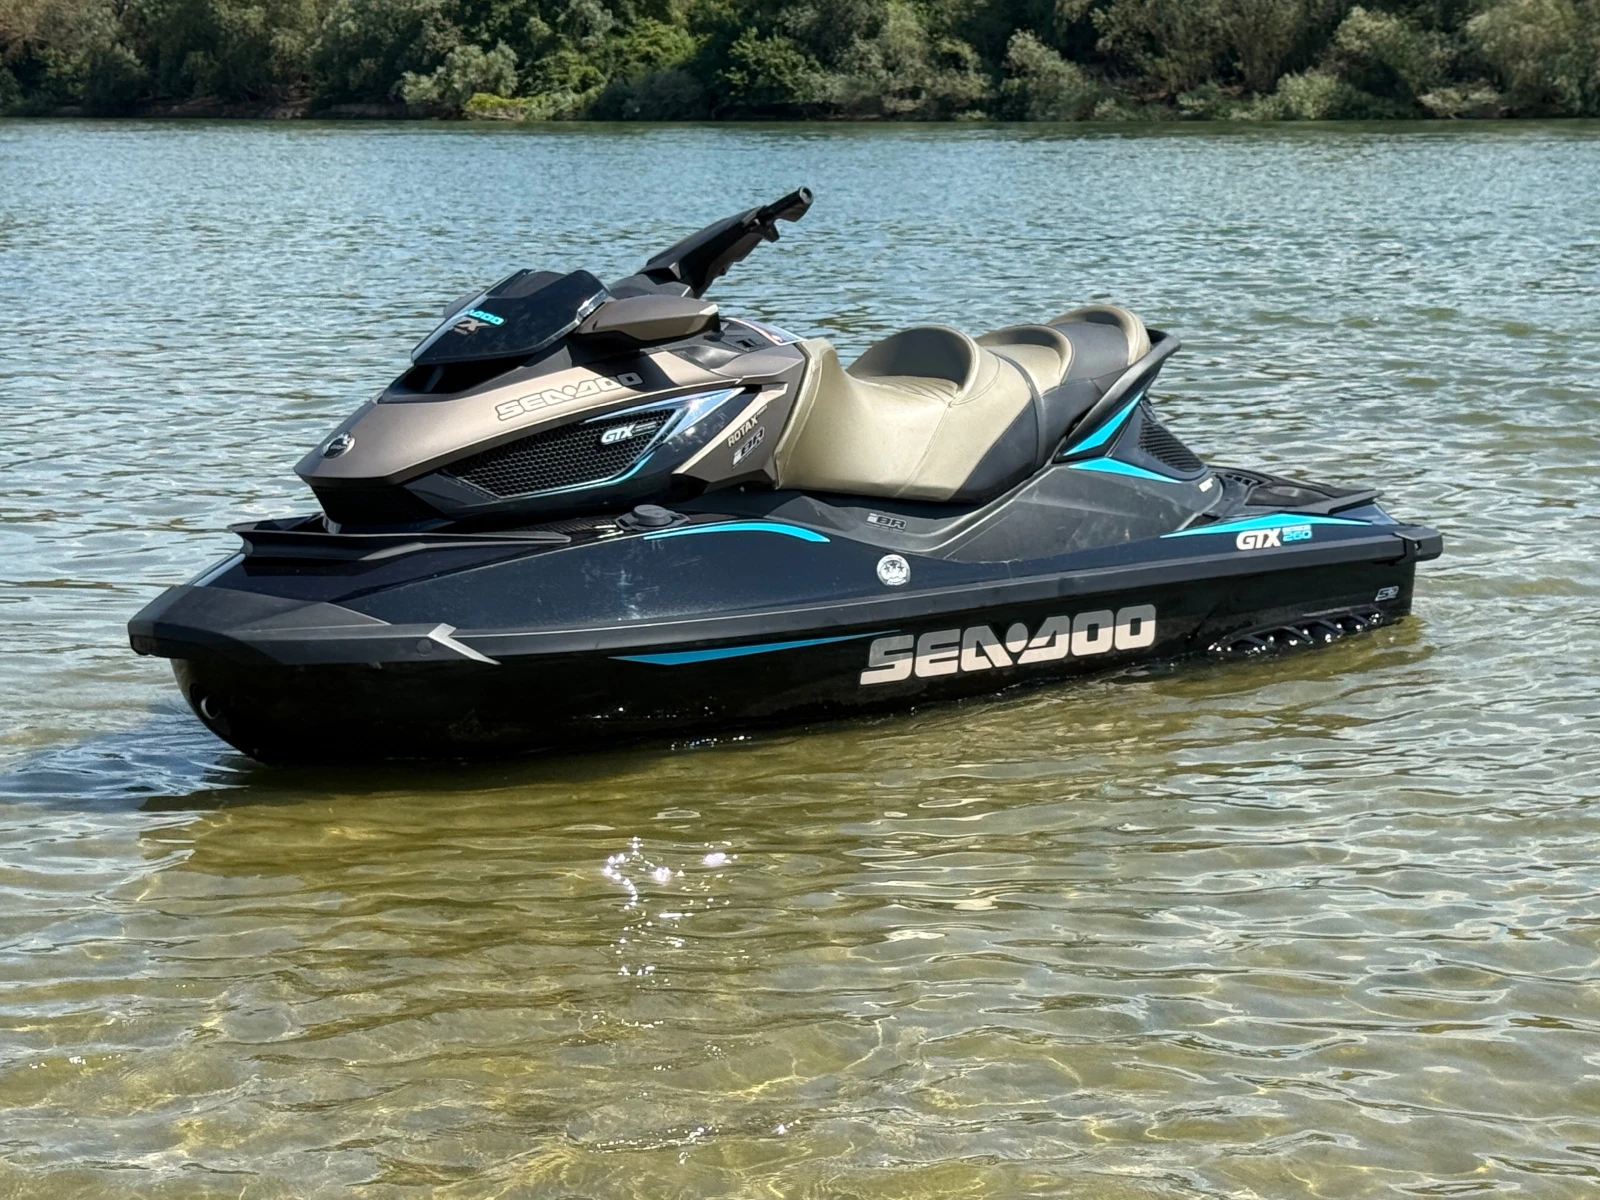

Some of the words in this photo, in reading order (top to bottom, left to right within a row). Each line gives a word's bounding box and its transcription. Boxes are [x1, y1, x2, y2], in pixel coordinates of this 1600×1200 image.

[601, 423, 636, 444] GTX
[727, 414, 758, 447] ROTAX
[1236, 527, 1281, 550] GTX
